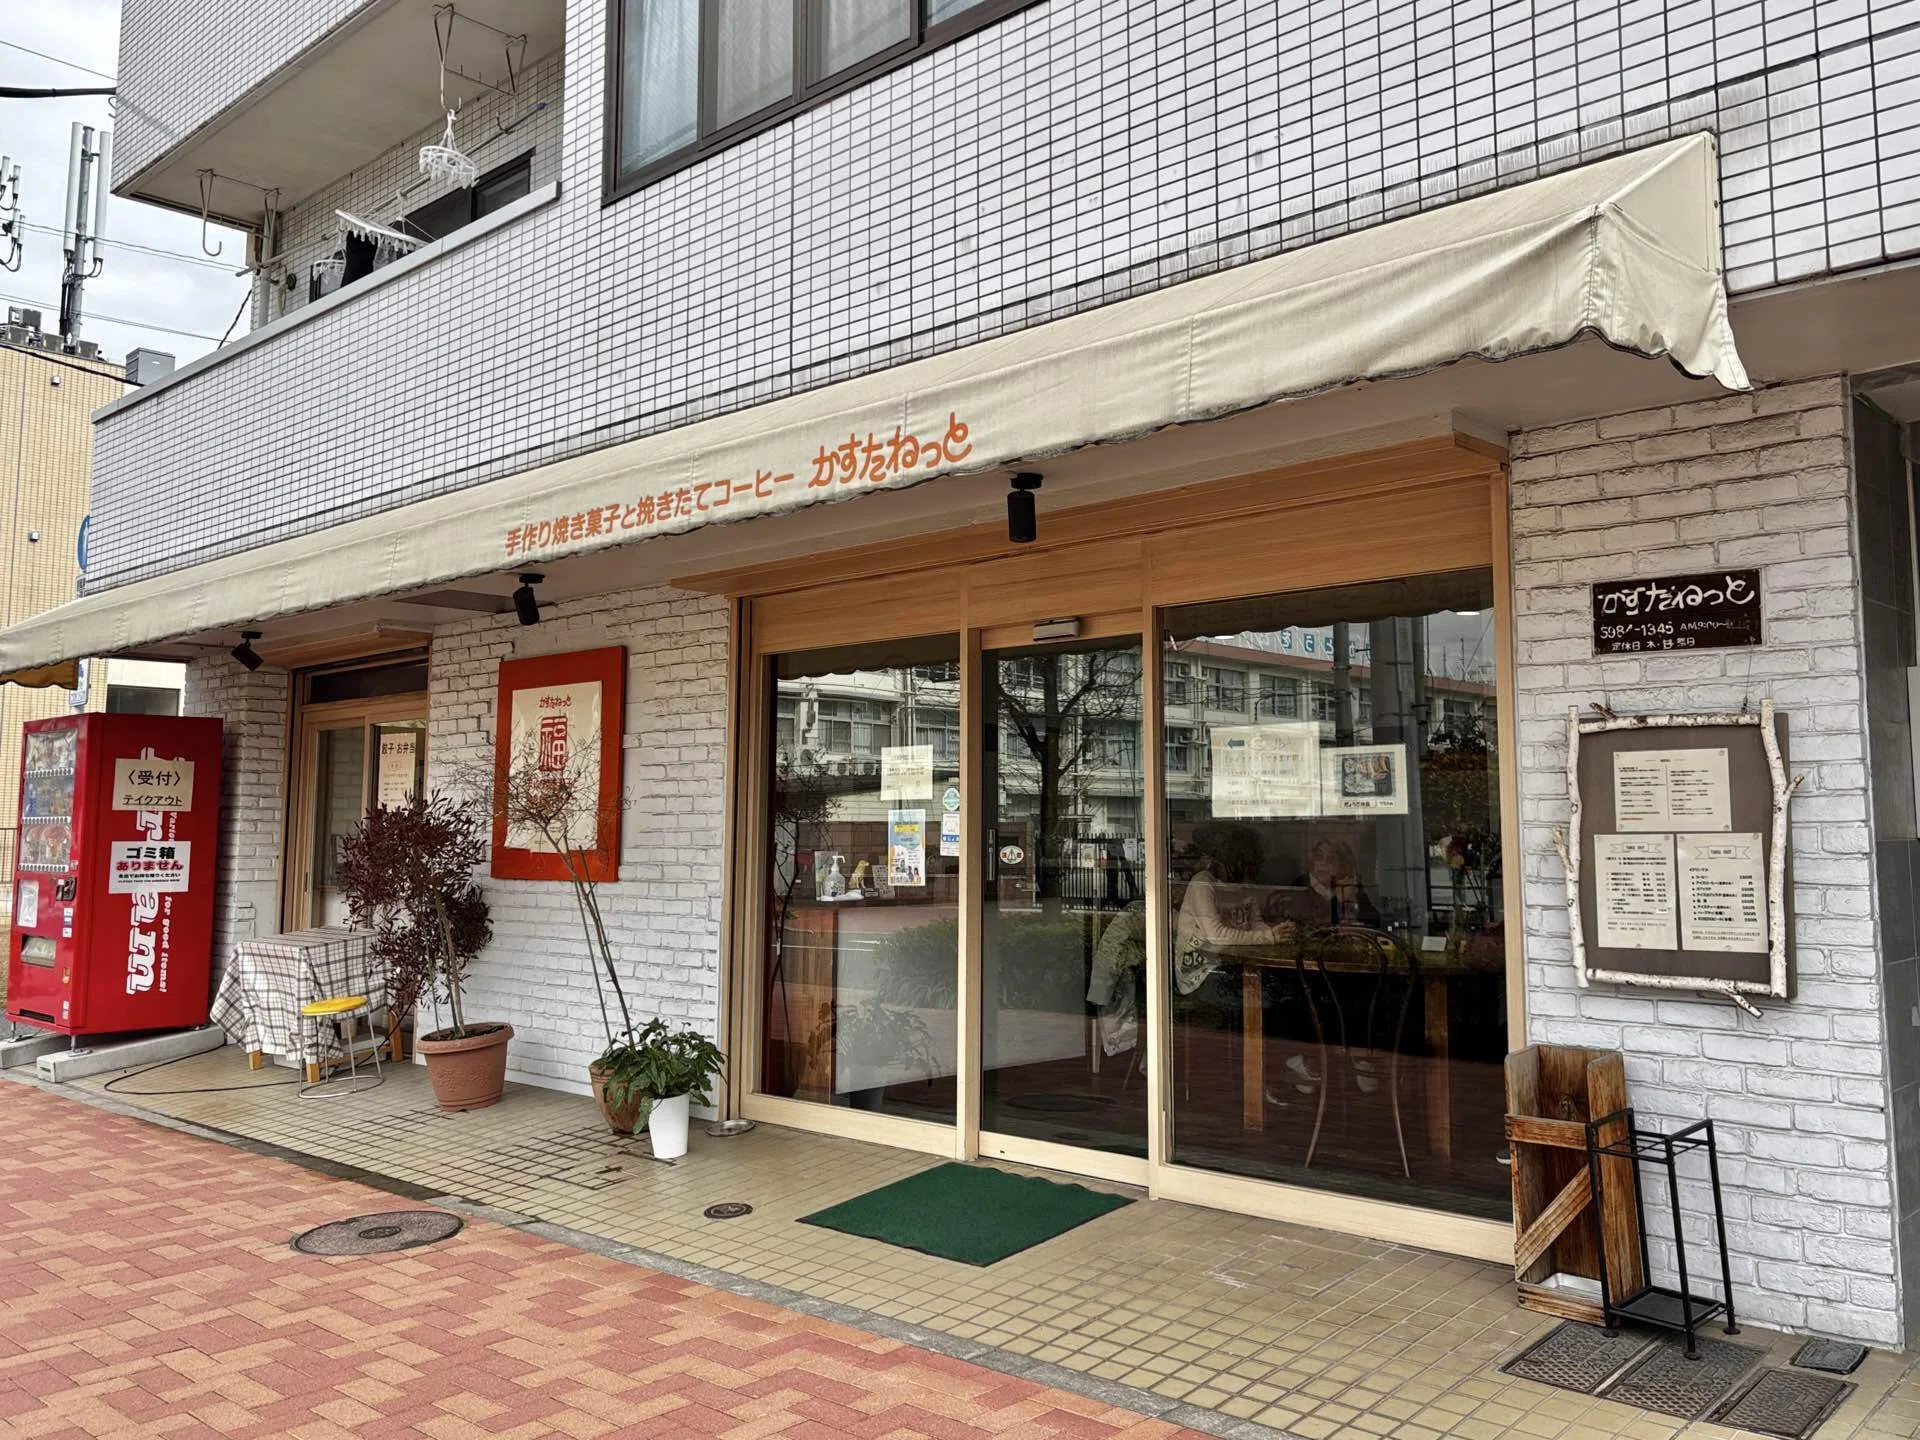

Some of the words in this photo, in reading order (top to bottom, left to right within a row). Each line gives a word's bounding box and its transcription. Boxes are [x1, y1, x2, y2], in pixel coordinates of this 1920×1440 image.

[505, 469, 796, 557] 手作り焼き菓子と挽きたてコーヒー
[807, 411, 973, 489] かすたねっと
[123, 794, 183, 806] テイクアウト
[126, 846, 176, 860] ゴミ箱
[116, 860, 183, 871] ありません
[164, 896, 173, 915] for
[162, 918, 170, 949] good
